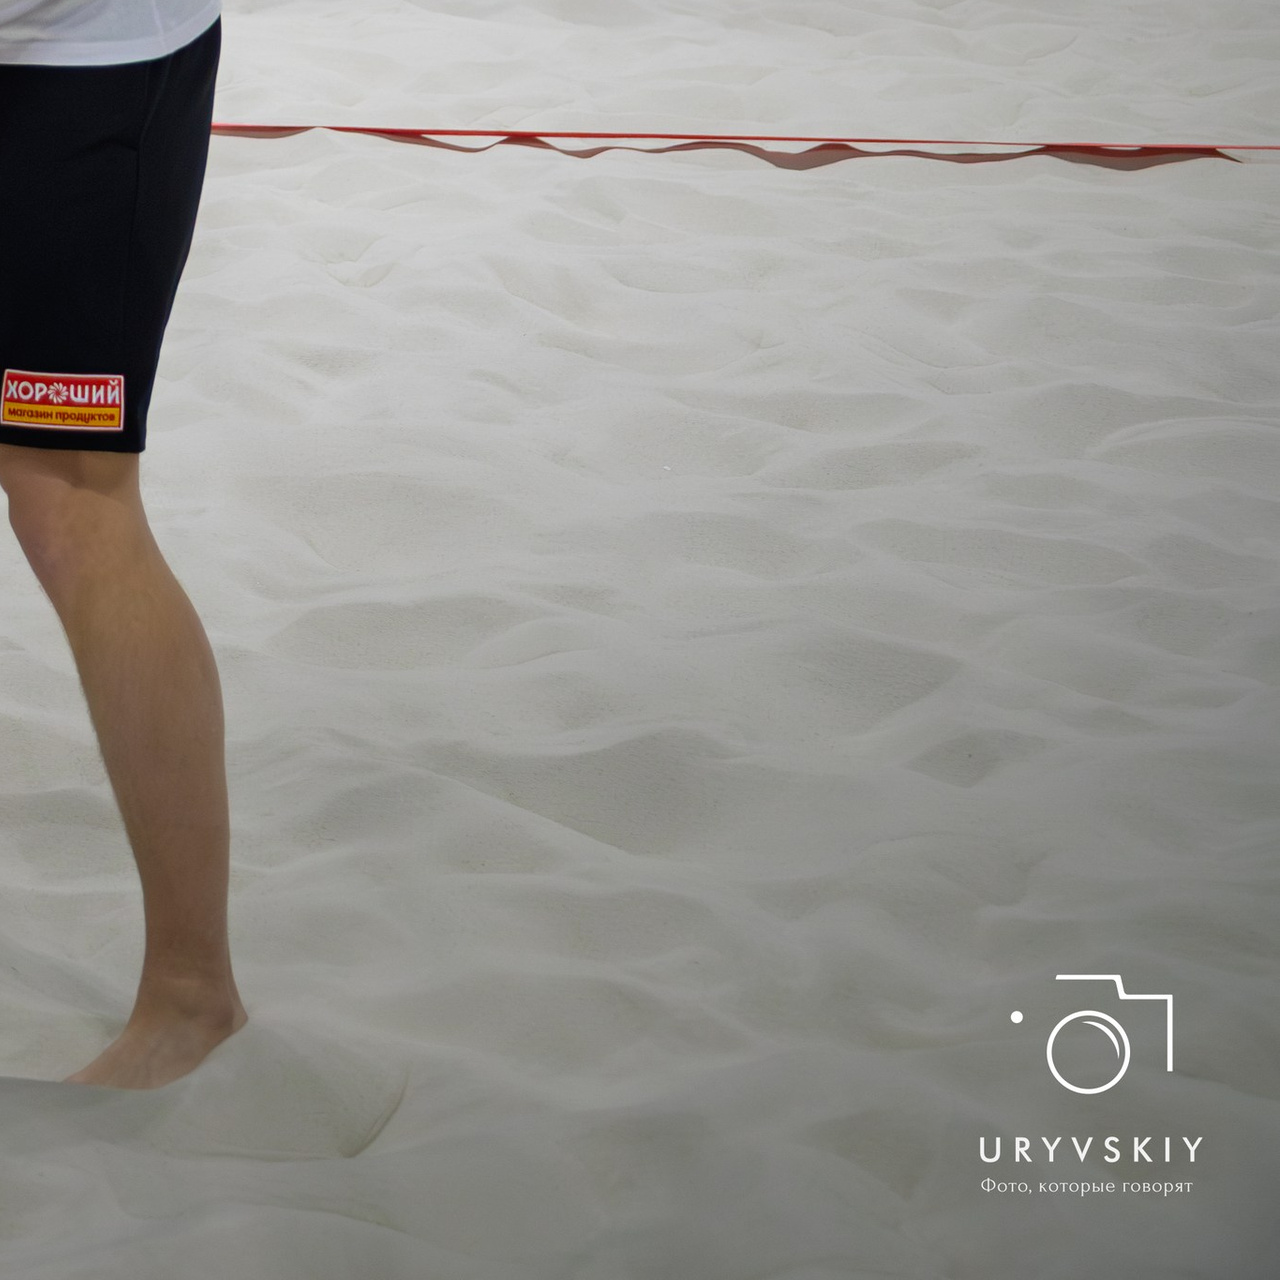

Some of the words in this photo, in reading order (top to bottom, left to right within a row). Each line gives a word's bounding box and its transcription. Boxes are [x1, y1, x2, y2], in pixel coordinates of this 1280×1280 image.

[5, 379, 121, 405] ХОРОШИЙ
[7, 407, 54, 420] магазин
[55, 412, 116, 425] продуктов
